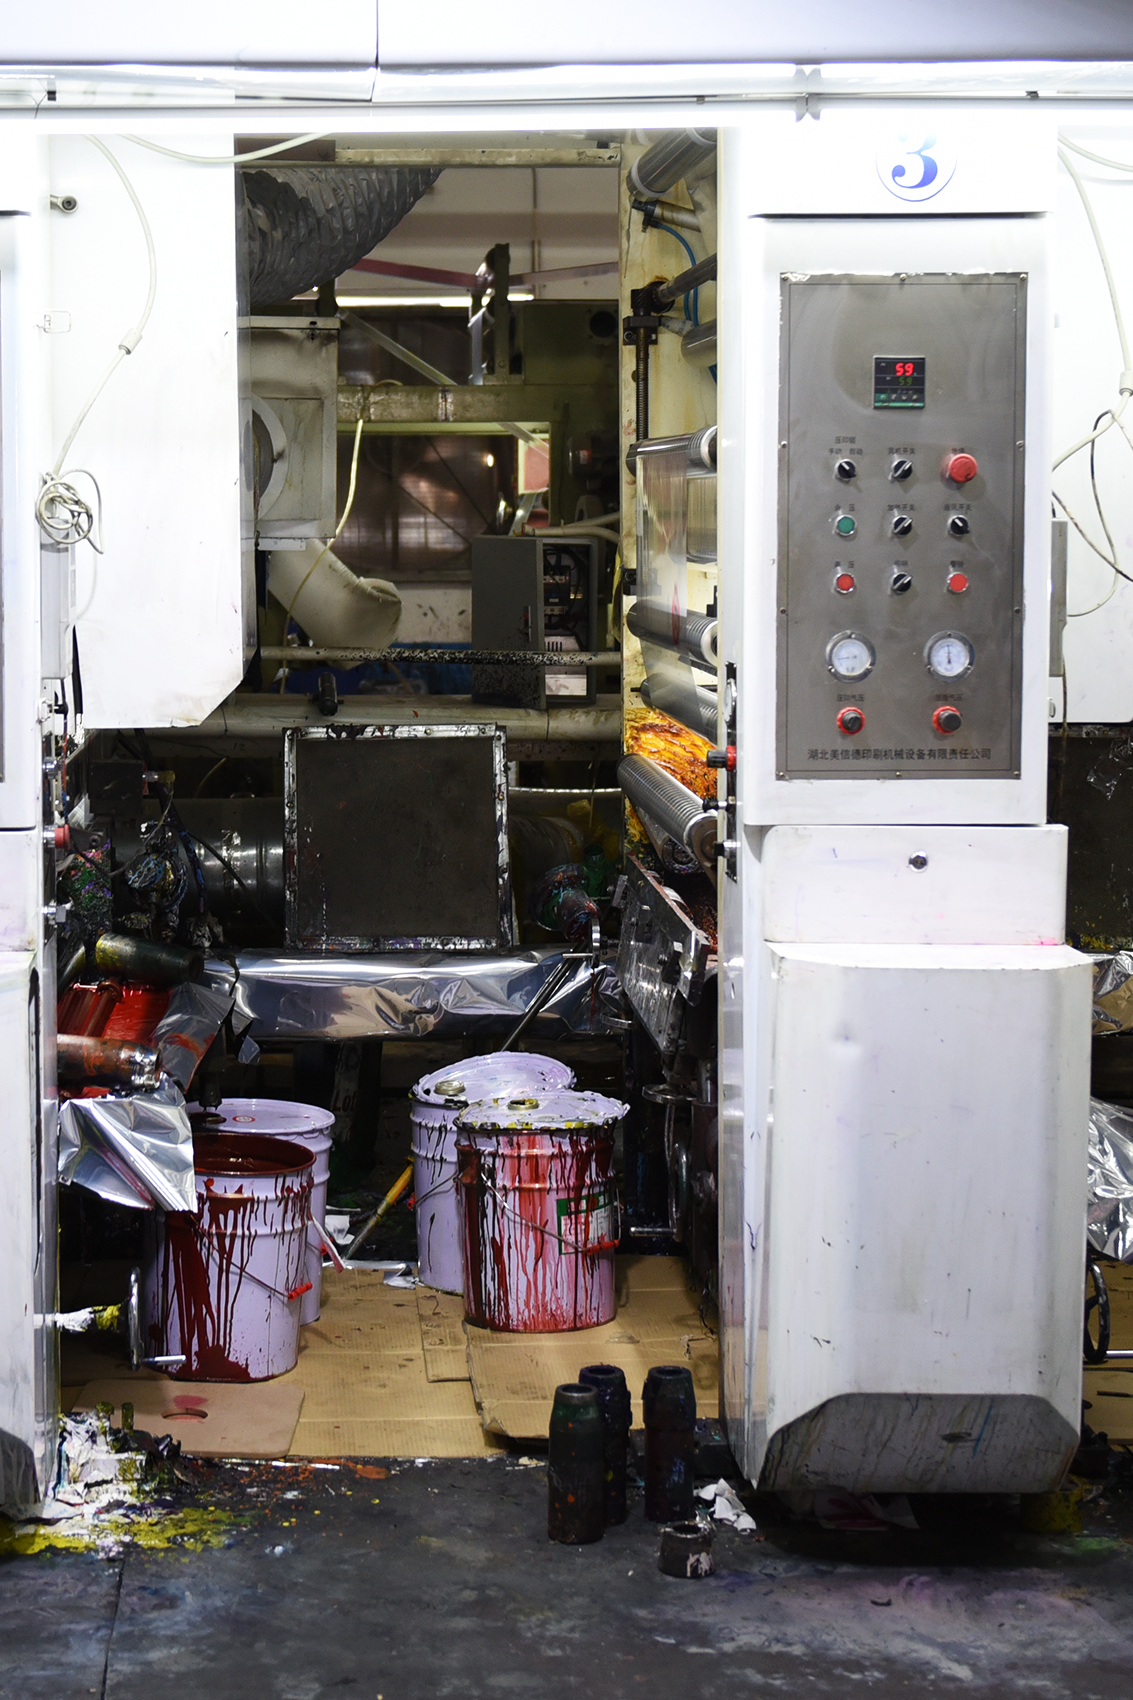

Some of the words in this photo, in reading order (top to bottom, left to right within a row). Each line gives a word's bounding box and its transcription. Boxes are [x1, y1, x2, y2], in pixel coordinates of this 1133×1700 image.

[891, 128, 938, 189] 3
[895, 362, 914, 376] 59
[899, 376, 913, 386] 59
[828, 447, 843, 455] 手动
[849, 447, 864, 455] 自动
[888, 447, 916, 455] 风机开关
[848, 504, 855, 512] 压
[807, 748, 992, 761] 湖北美信德印刷机械设备有限责任公司
